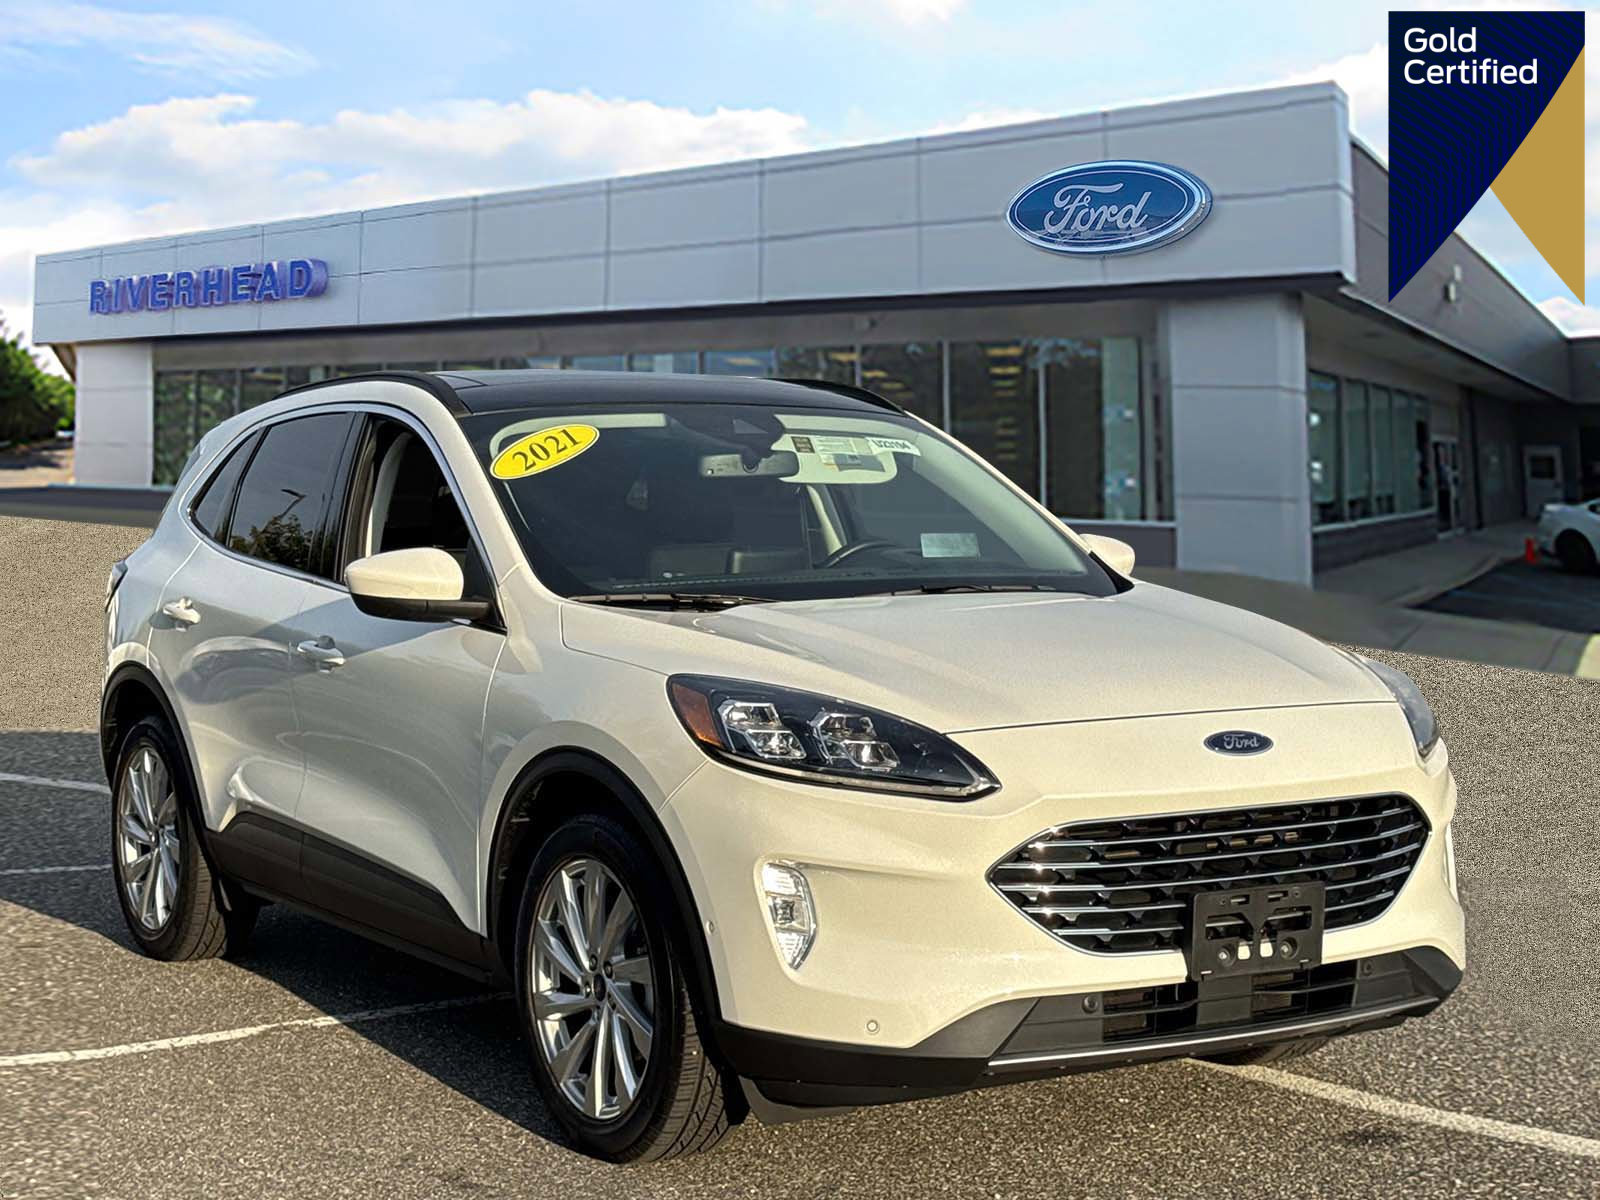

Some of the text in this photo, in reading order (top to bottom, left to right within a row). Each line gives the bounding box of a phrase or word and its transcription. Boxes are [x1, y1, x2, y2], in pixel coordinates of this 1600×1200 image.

[1044, 183, 1152, 234] Ford
[90, 259, 328, 315] RIVERHEAD
[512, 429, 582, 471] 2021
[1223, 733, 1260, 749] Ford
